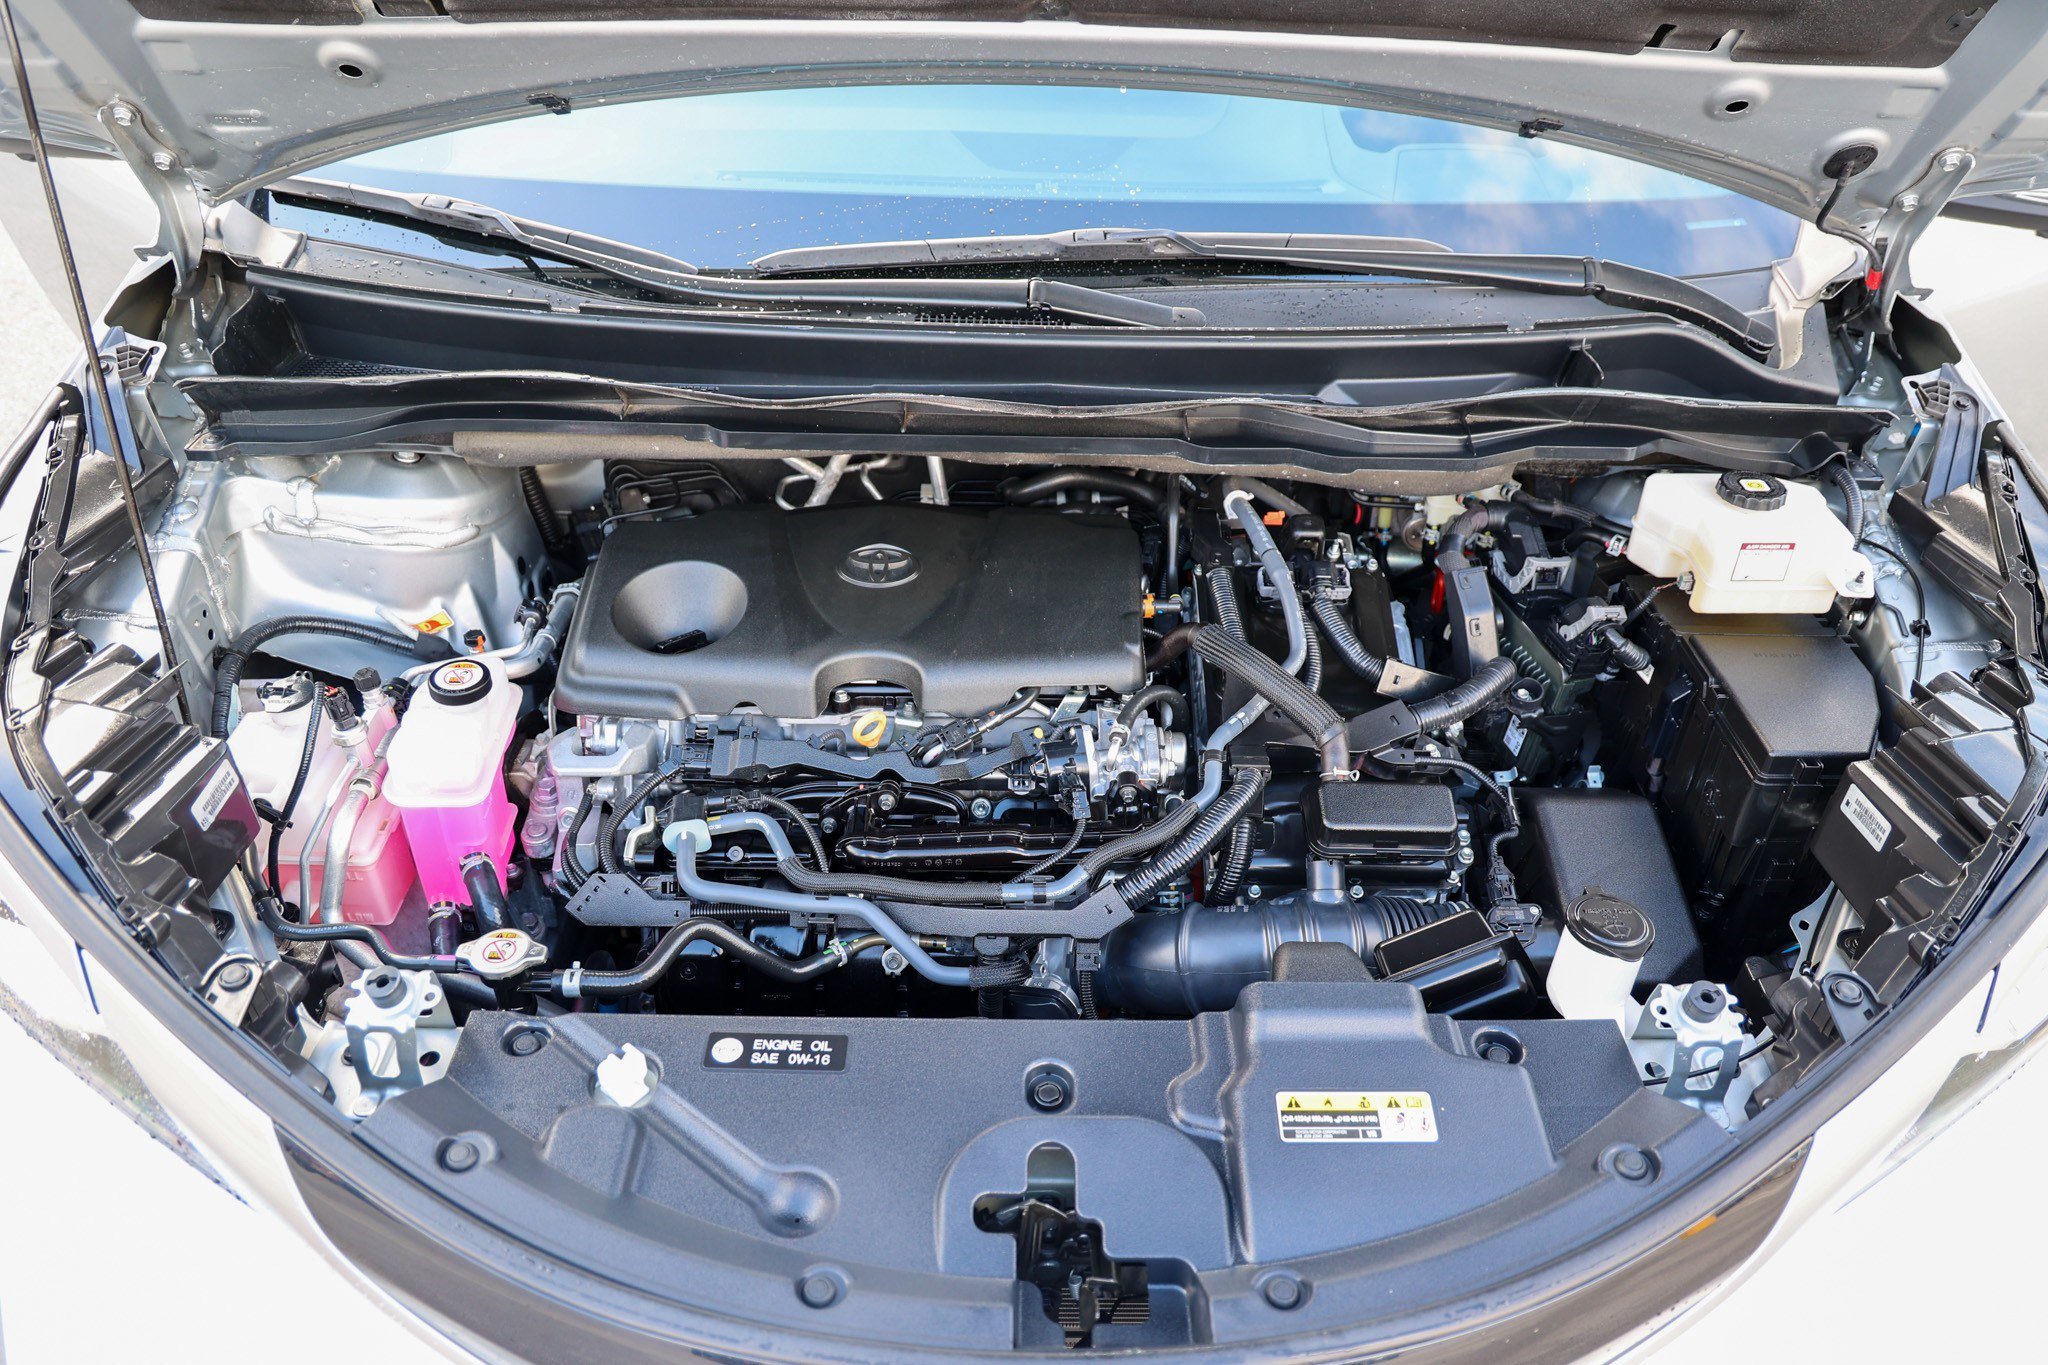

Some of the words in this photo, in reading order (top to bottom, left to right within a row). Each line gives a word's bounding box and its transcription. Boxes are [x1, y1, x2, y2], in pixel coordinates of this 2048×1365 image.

[753, 1038, 803, 1051] ENGINE
[810, 1040, 833, 1052] OIL
[750, 1052, 780, 1064] SAE
[788, 1053, 831, 1066] 0W-16
